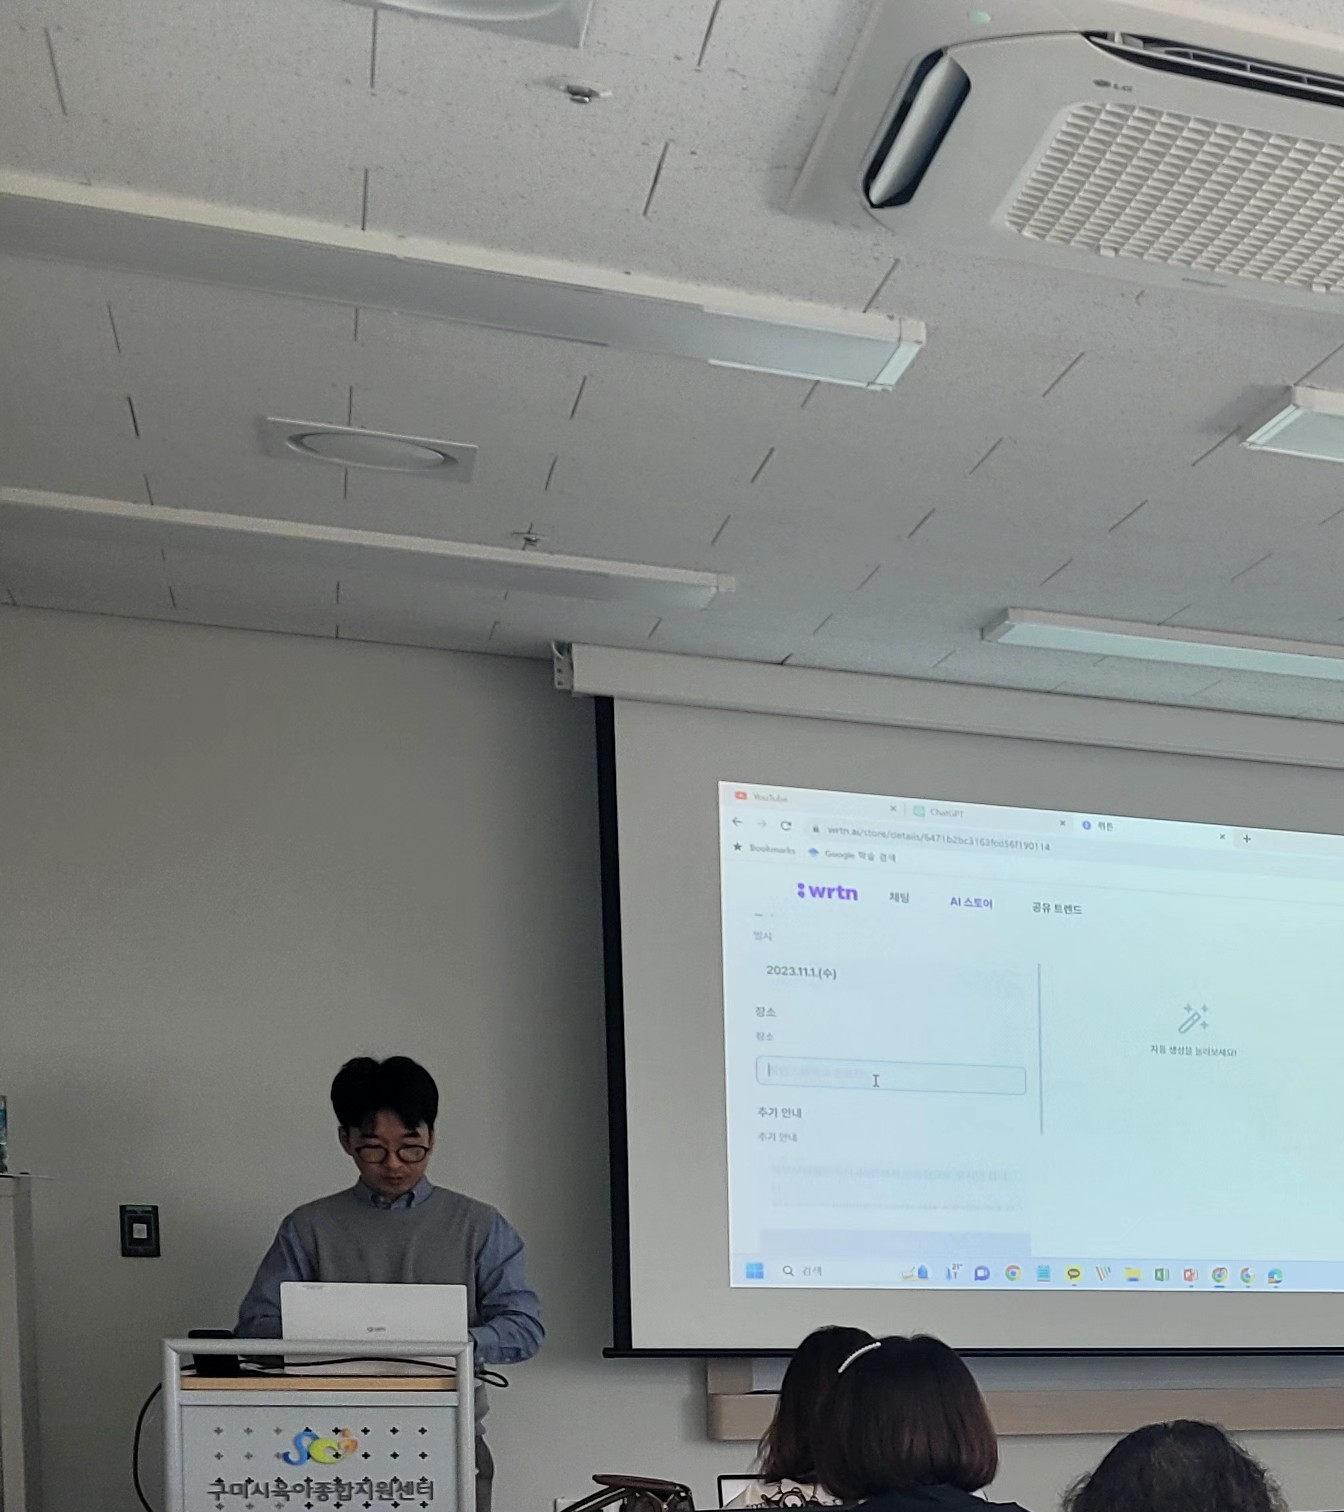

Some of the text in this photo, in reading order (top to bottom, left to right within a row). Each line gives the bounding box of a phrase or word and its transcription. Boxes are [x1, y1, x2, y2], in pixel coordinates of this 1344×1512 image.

[930, 808, 964, 818] ChatGPT
[749, 844, 795, 856] Bookmarks
[825, 850, 855, 861] Google
[809, 884, 858, 901] wrtn
[950, 897, 993, 909] AI 스토어
[1032, 901, 1083, 915] 공유 트렌드
[755, 1006, 776, 1018] 장소
[207, 1480, 434, 1501] 구미시육아종합지원센터
